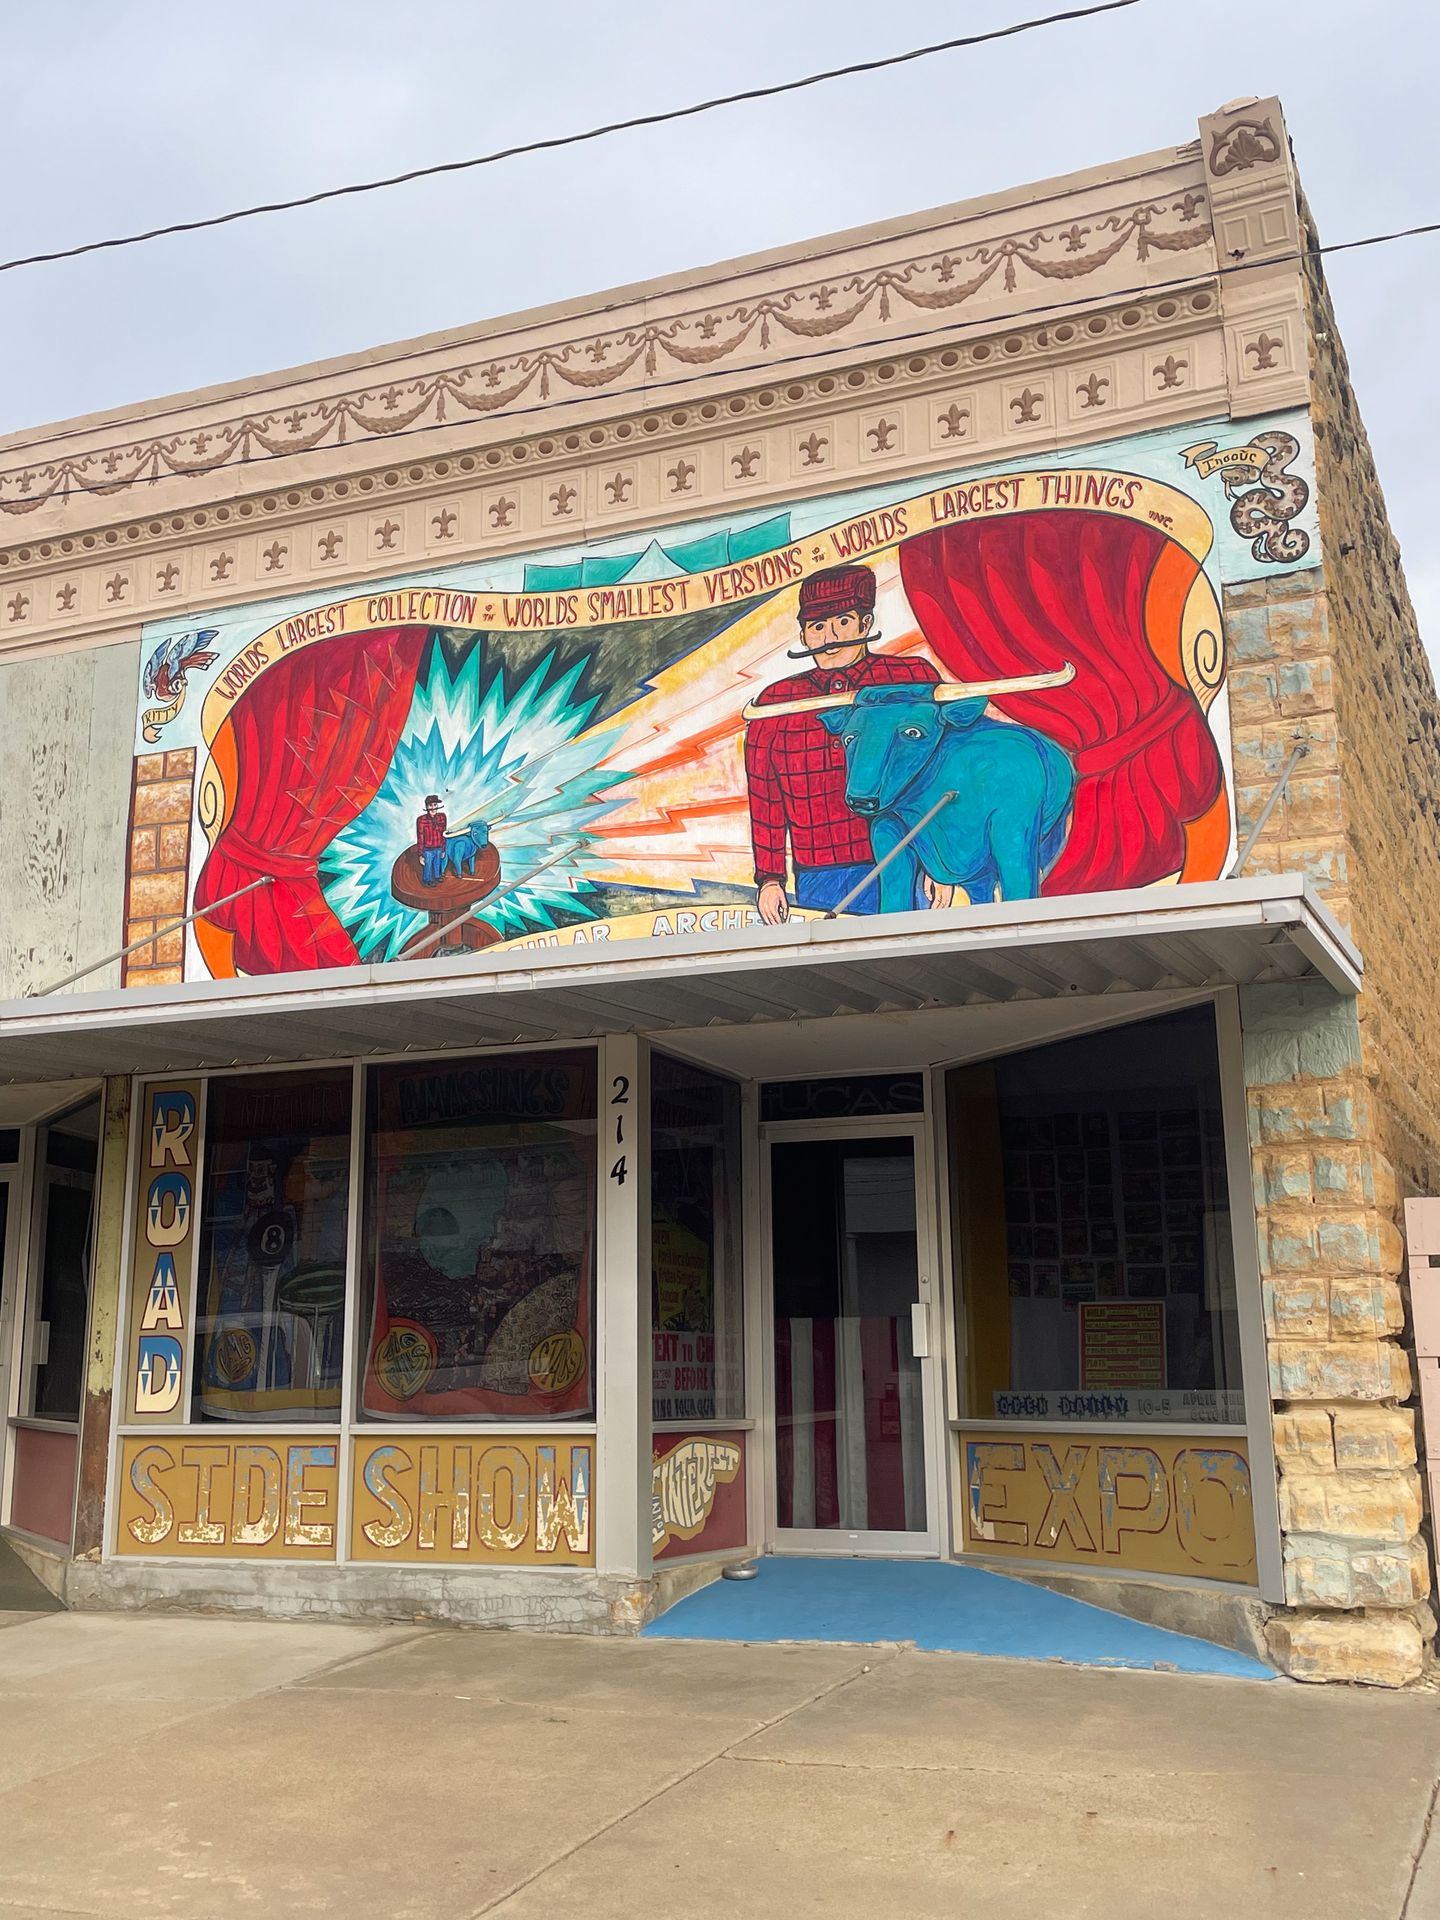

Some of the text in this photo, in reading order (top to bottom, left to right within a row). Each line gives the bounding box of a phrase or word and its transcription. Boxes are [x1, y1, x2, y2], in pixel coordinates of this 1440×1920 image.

[215, 641, 269, 700] WORLDS
[275, 604, 348, 651] LARGEST
[367, 592, 477, 624] COLLECTION
[503, 595, 578, 628] WORLDS
[589, 580, 690, 623] SMALLEST
[704, 547, 803, 603] VERSIONS
[830, 506, 908, 558] WORLDS
[929, 478, 1026, 524] LARGEST
[1037, 474, 1142, 510] THINGS
[145, 704, 178, 724] KITTY
[135, 1090, 197, 1414] ROAD
[651, 1332, 679, 1362] EXT
[674, 1367, 709, 1392] BEFORE
[997, 1393, 1171, 1419] OPEN DAILY 10-5
[127, 1444, 592, 1553] SIDE SHOW
[661, 1442, 739, 1528] INTEREST
[966, 1442, 1252, 1567] EXPO
